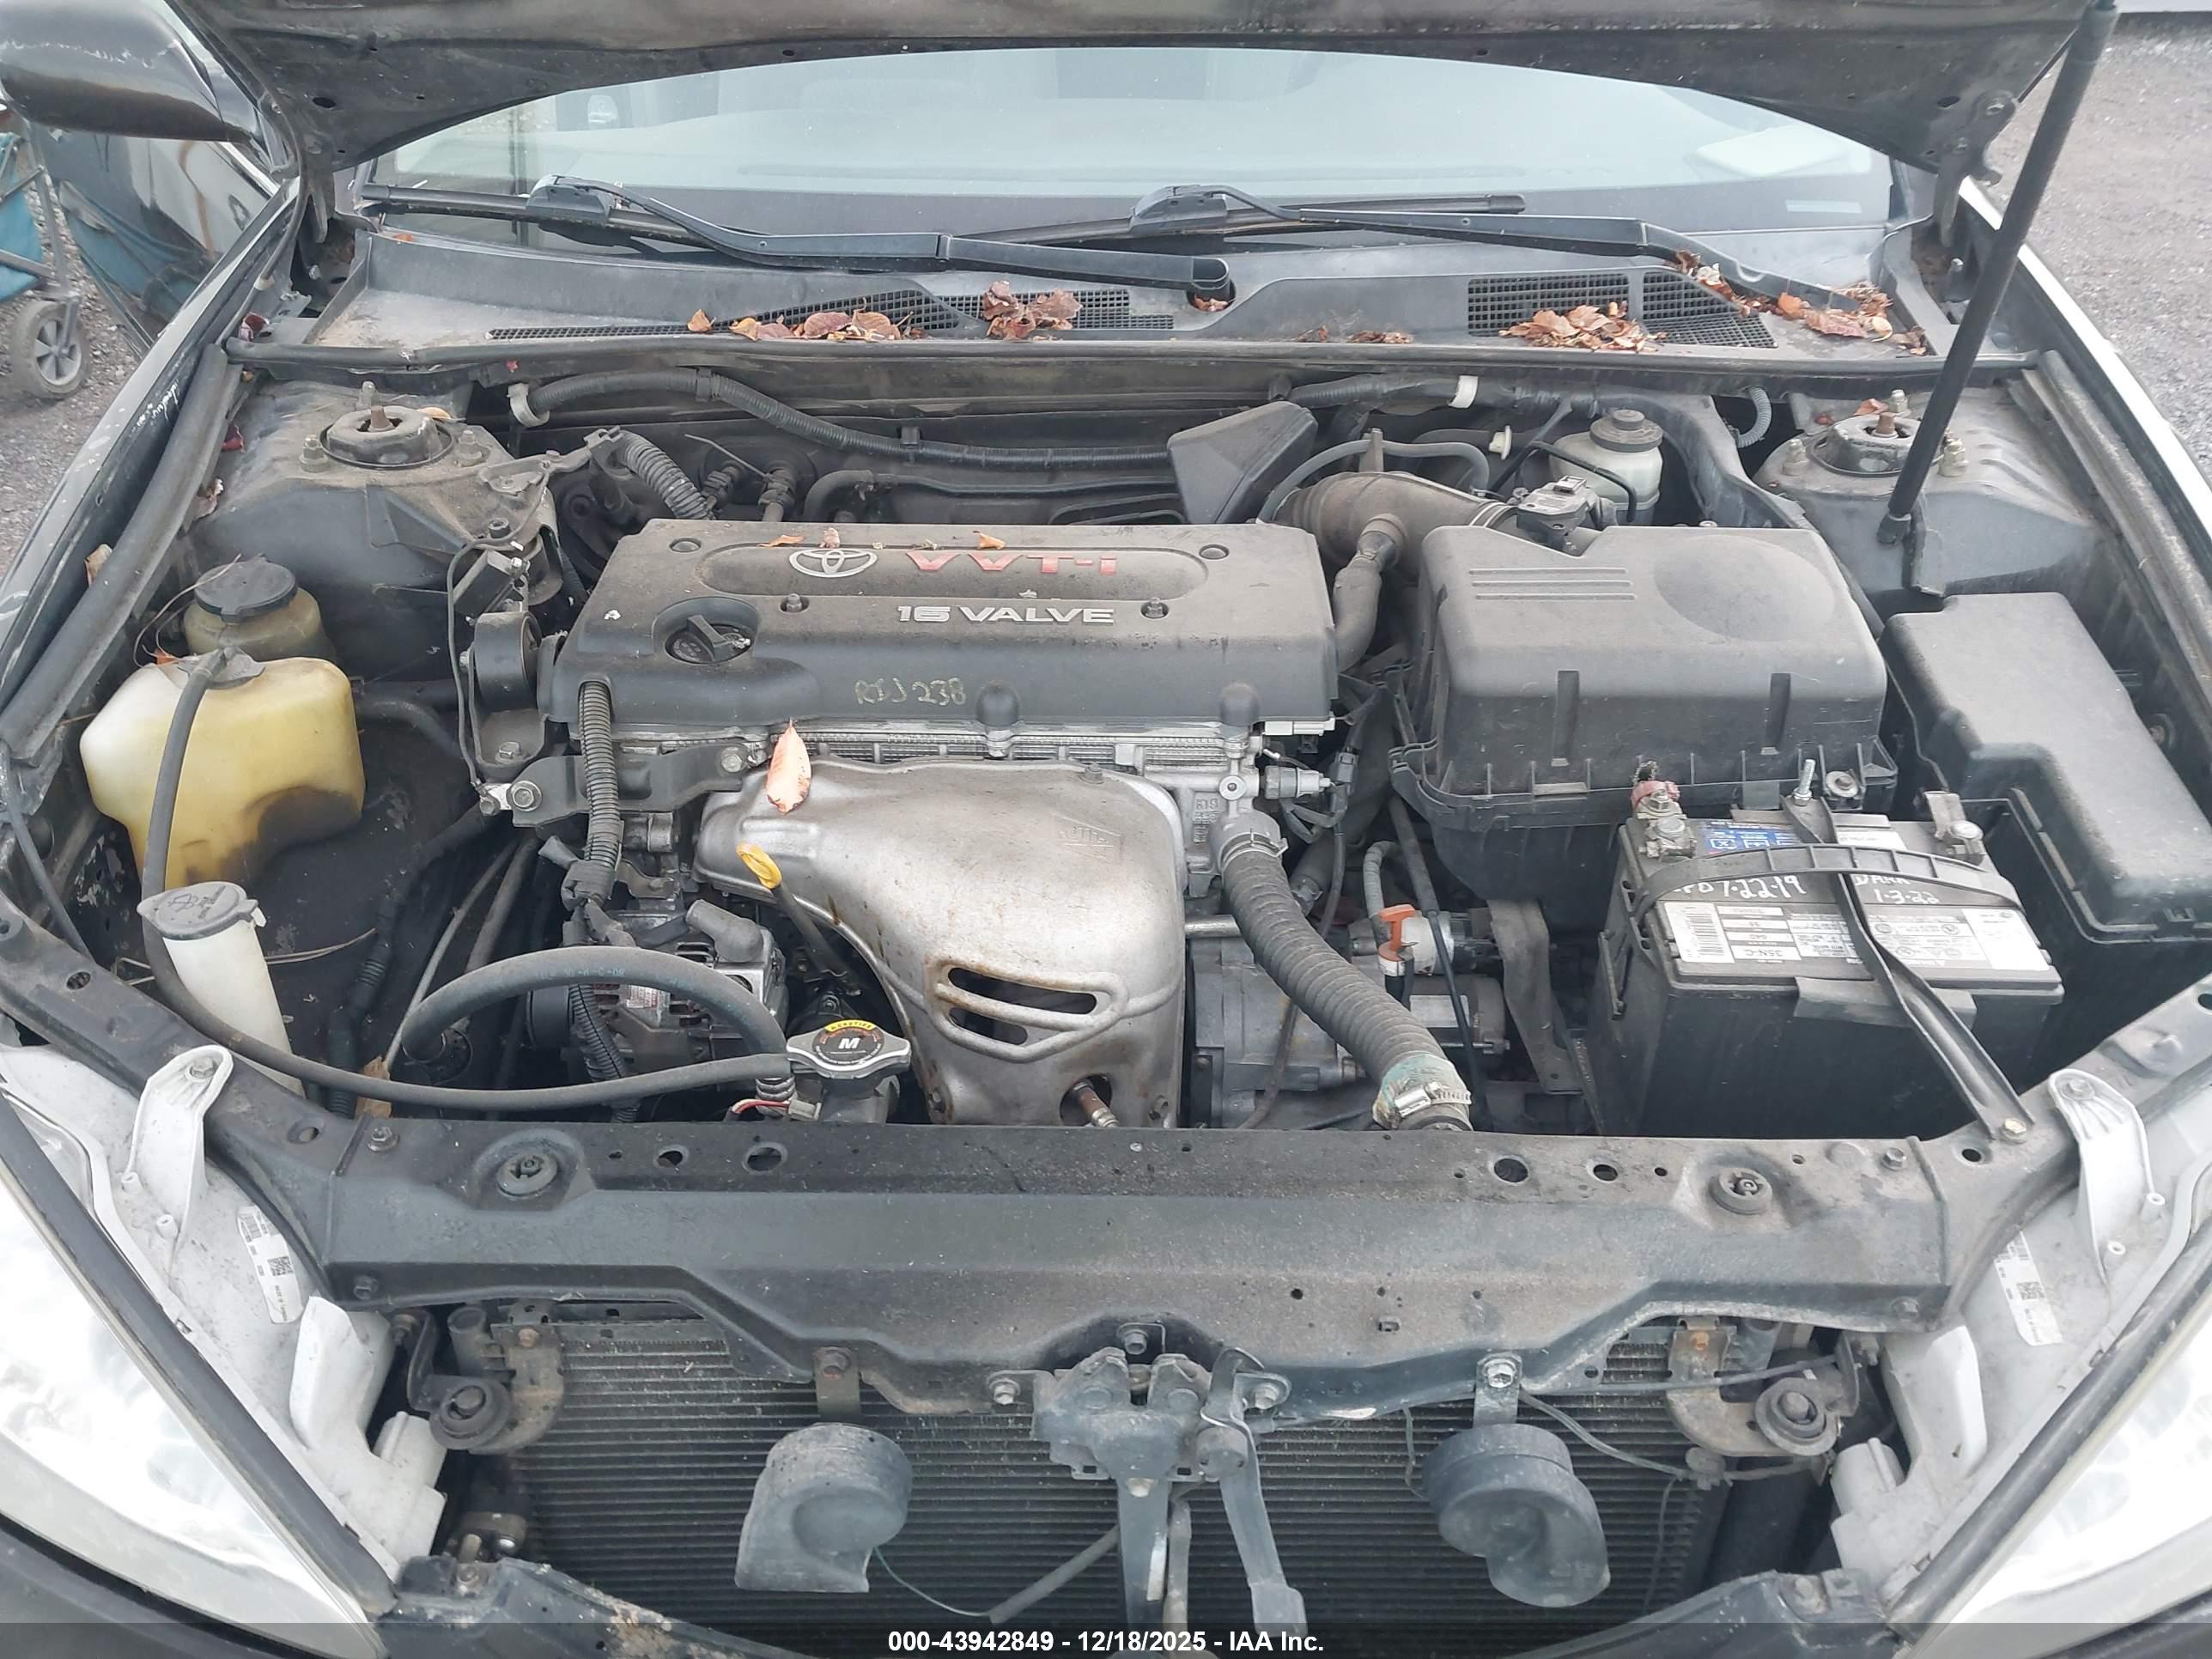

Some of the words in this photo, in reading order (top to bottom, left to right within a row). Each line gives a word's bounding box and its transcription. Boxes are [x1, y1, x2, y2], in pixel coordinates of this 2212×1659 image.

[897, 605, 951, 623] 16
[957, 605, 1115, 623] VALVE
[912, 677, 966, 706] 238
